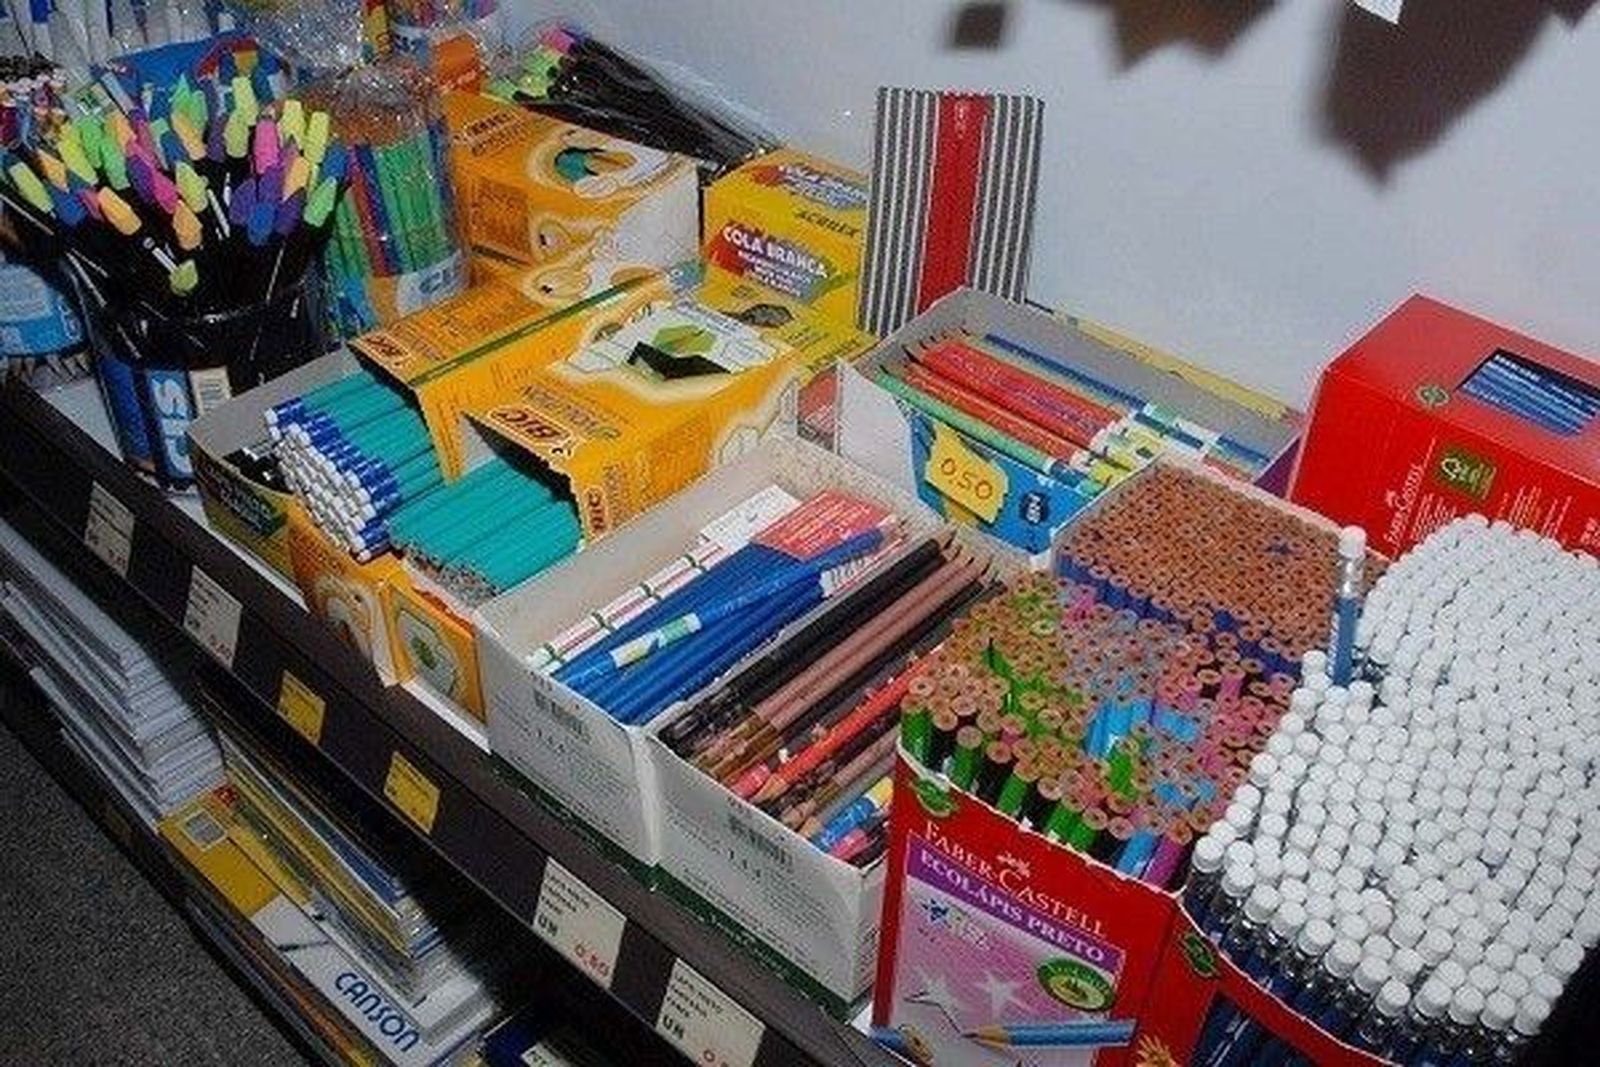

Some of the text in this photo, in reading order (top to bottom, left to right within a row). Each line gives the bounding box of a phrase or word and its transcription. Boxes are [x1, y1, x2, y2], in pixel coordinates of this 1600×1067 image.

[723, 224, 763, 255] COLA
[1027, 916, 1105, 963] PRETO
[333, 971, 421, 1052] CANSON
